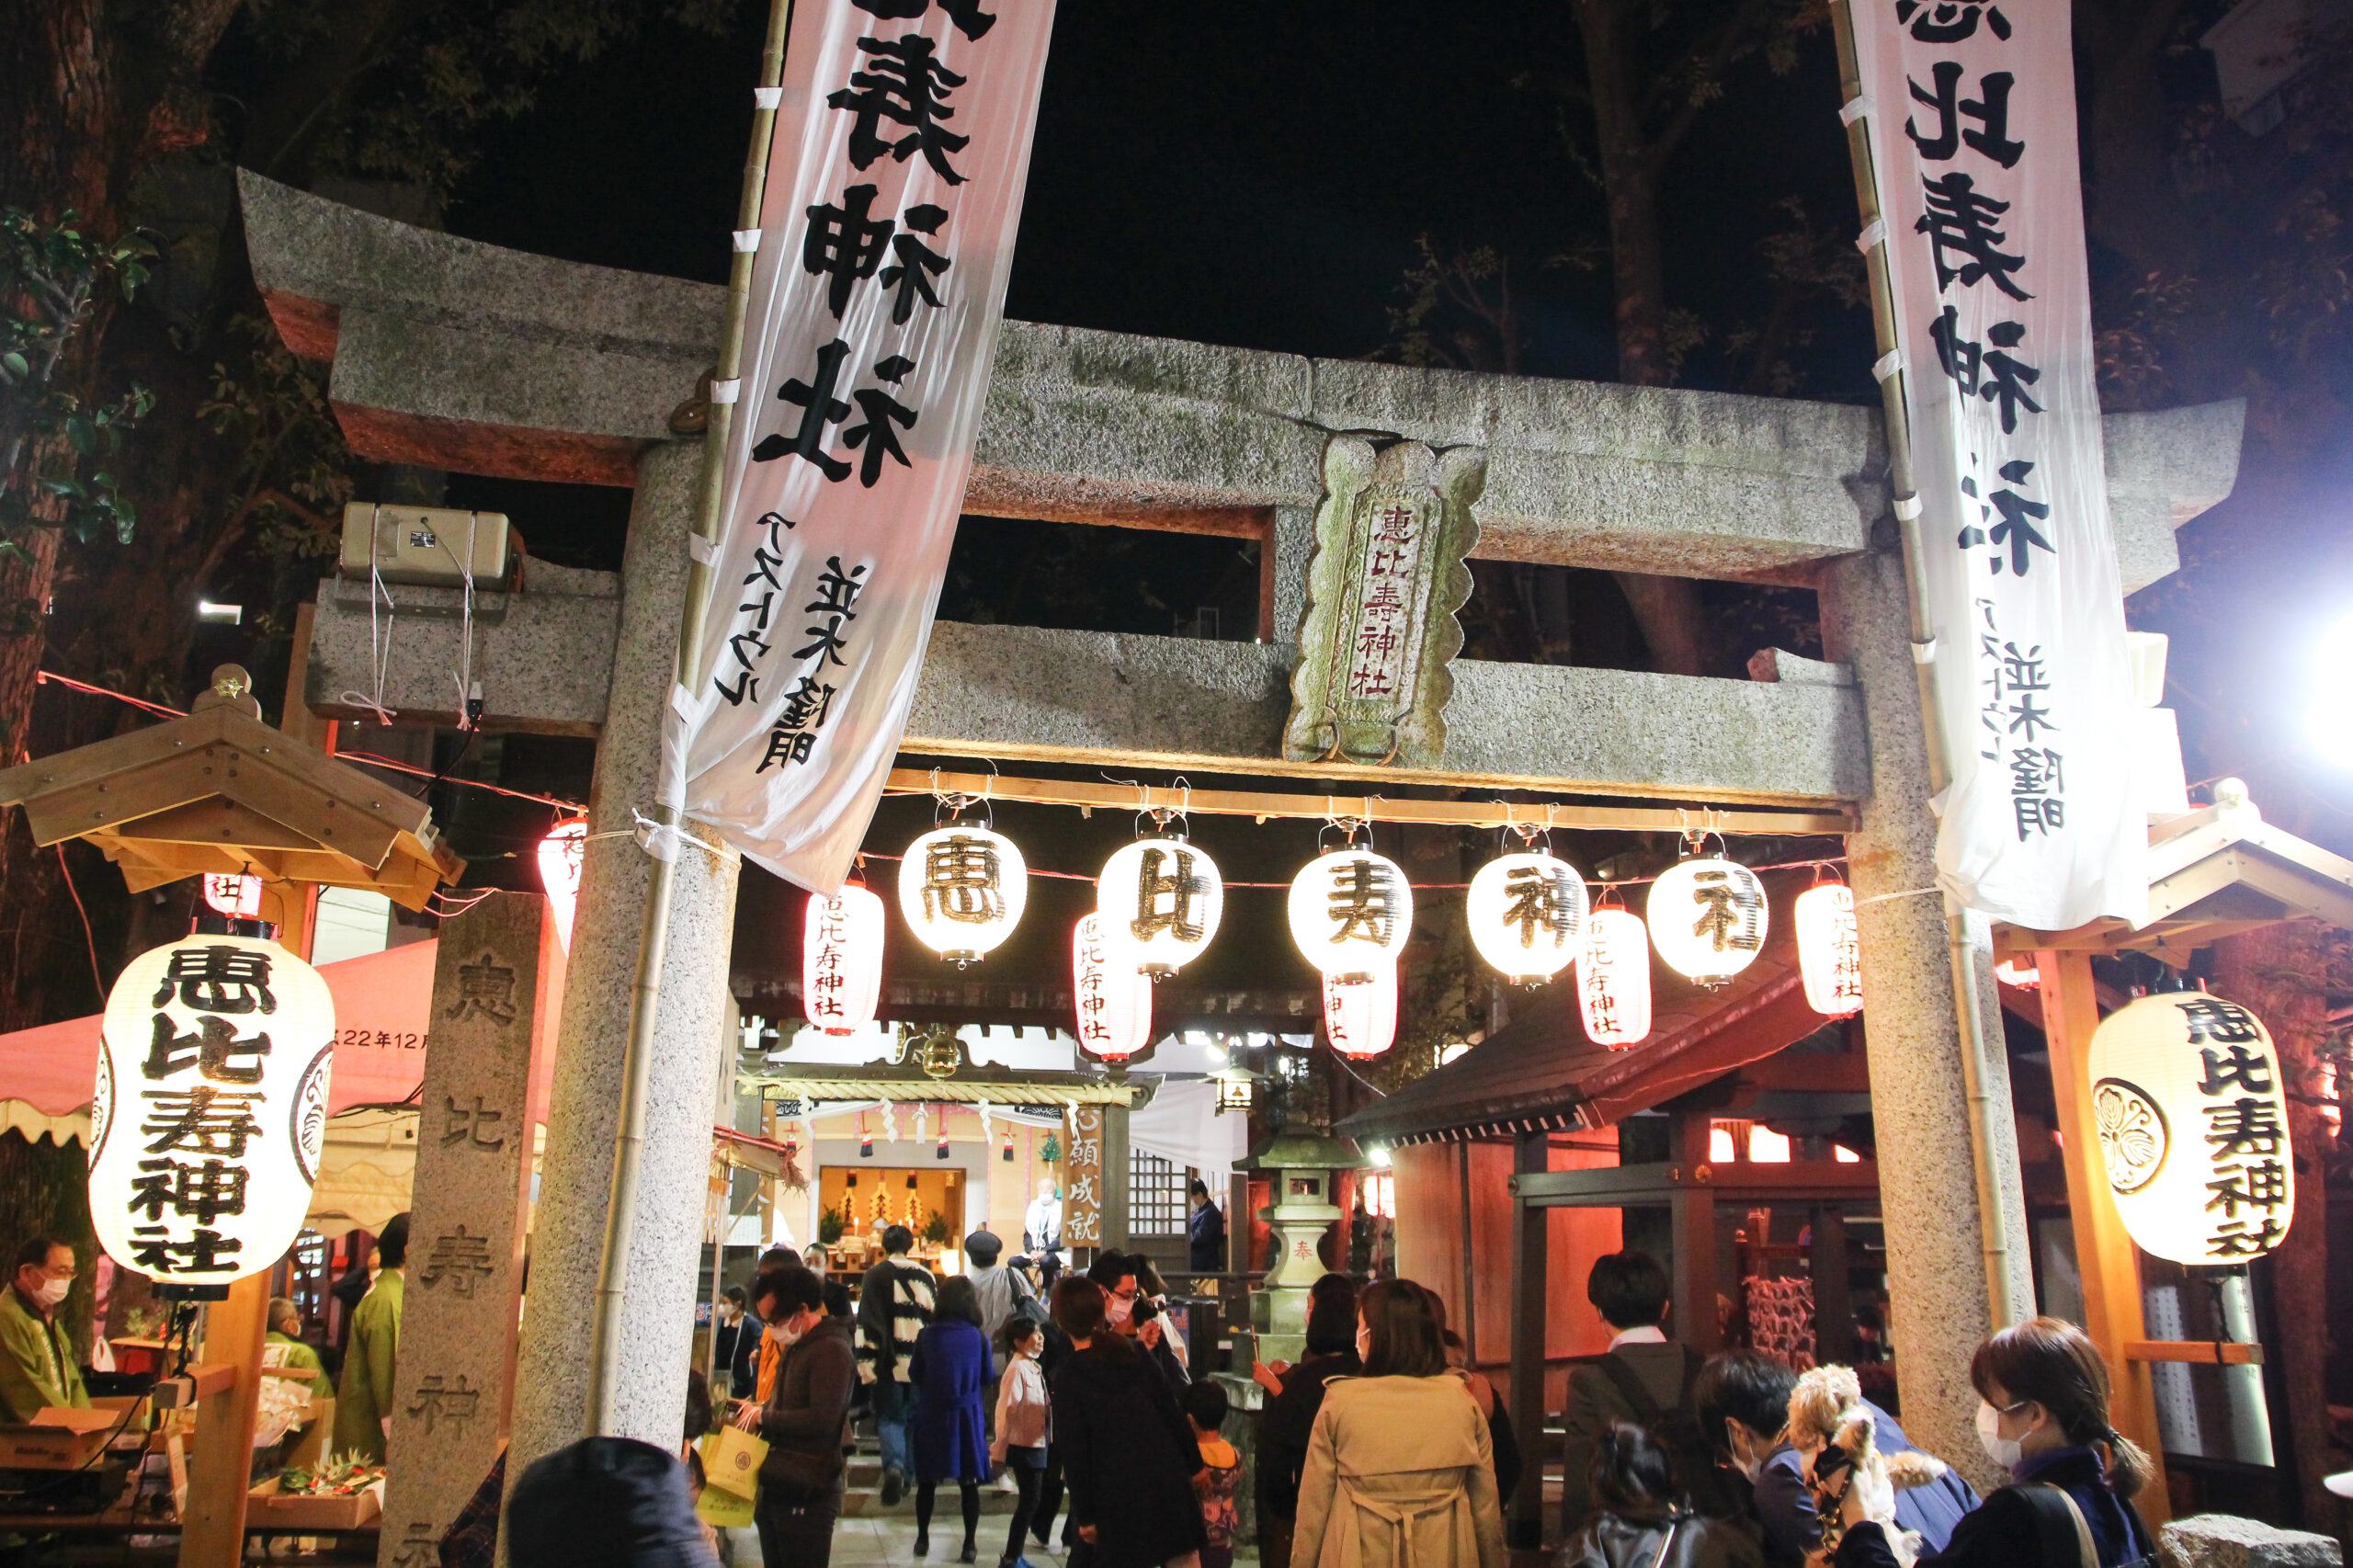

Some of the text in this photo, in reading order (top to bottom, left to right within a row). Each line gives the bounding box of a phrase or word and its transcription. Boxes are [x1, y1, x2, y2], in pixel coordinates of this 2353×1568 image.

[128, 945, 277, 1274] 恵比寿神社
[2175, 998, 2287, 1256] 恵比寿神社
[1293, 1241, 1314, 1261] 奉
